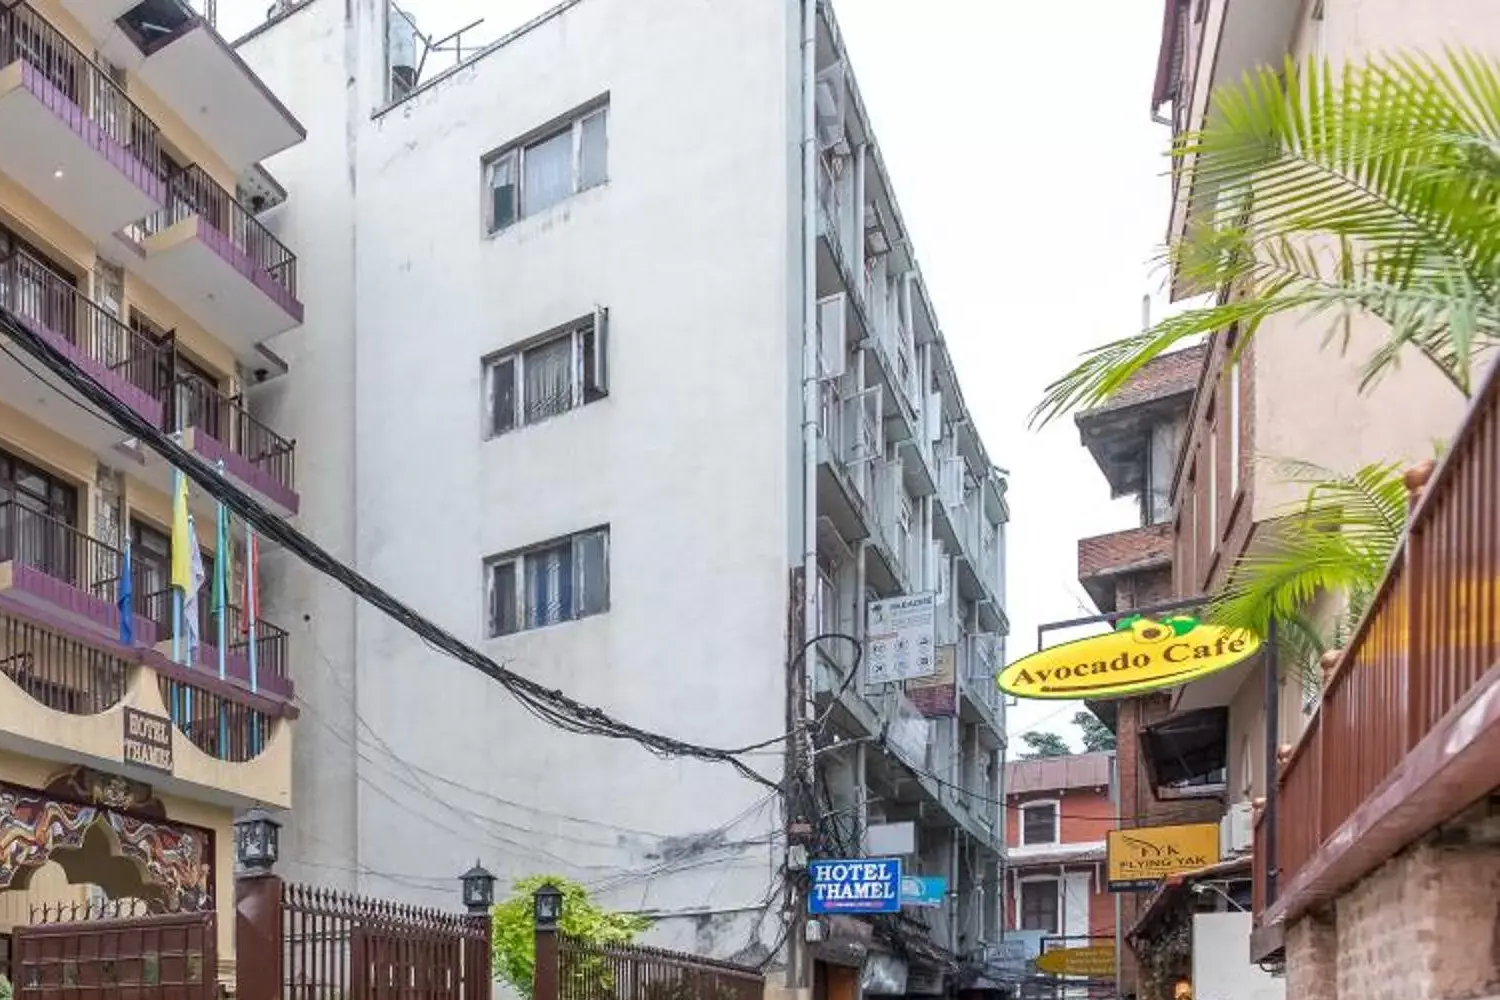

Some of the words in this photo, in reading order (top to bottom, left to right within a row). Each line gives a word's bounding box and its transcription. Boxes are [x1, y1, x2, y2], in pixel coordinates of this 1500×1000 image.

[1012, 652, 1150, 687] Avocado
[129, 712, 169, 744] HOTEL
[1119, 857, 1171, 869] FLYING
[1178, 855, 1206, 865] YAK
[816, 863, 892, 881] HOTEL
[815, 881, 895, 900] THAMEL
